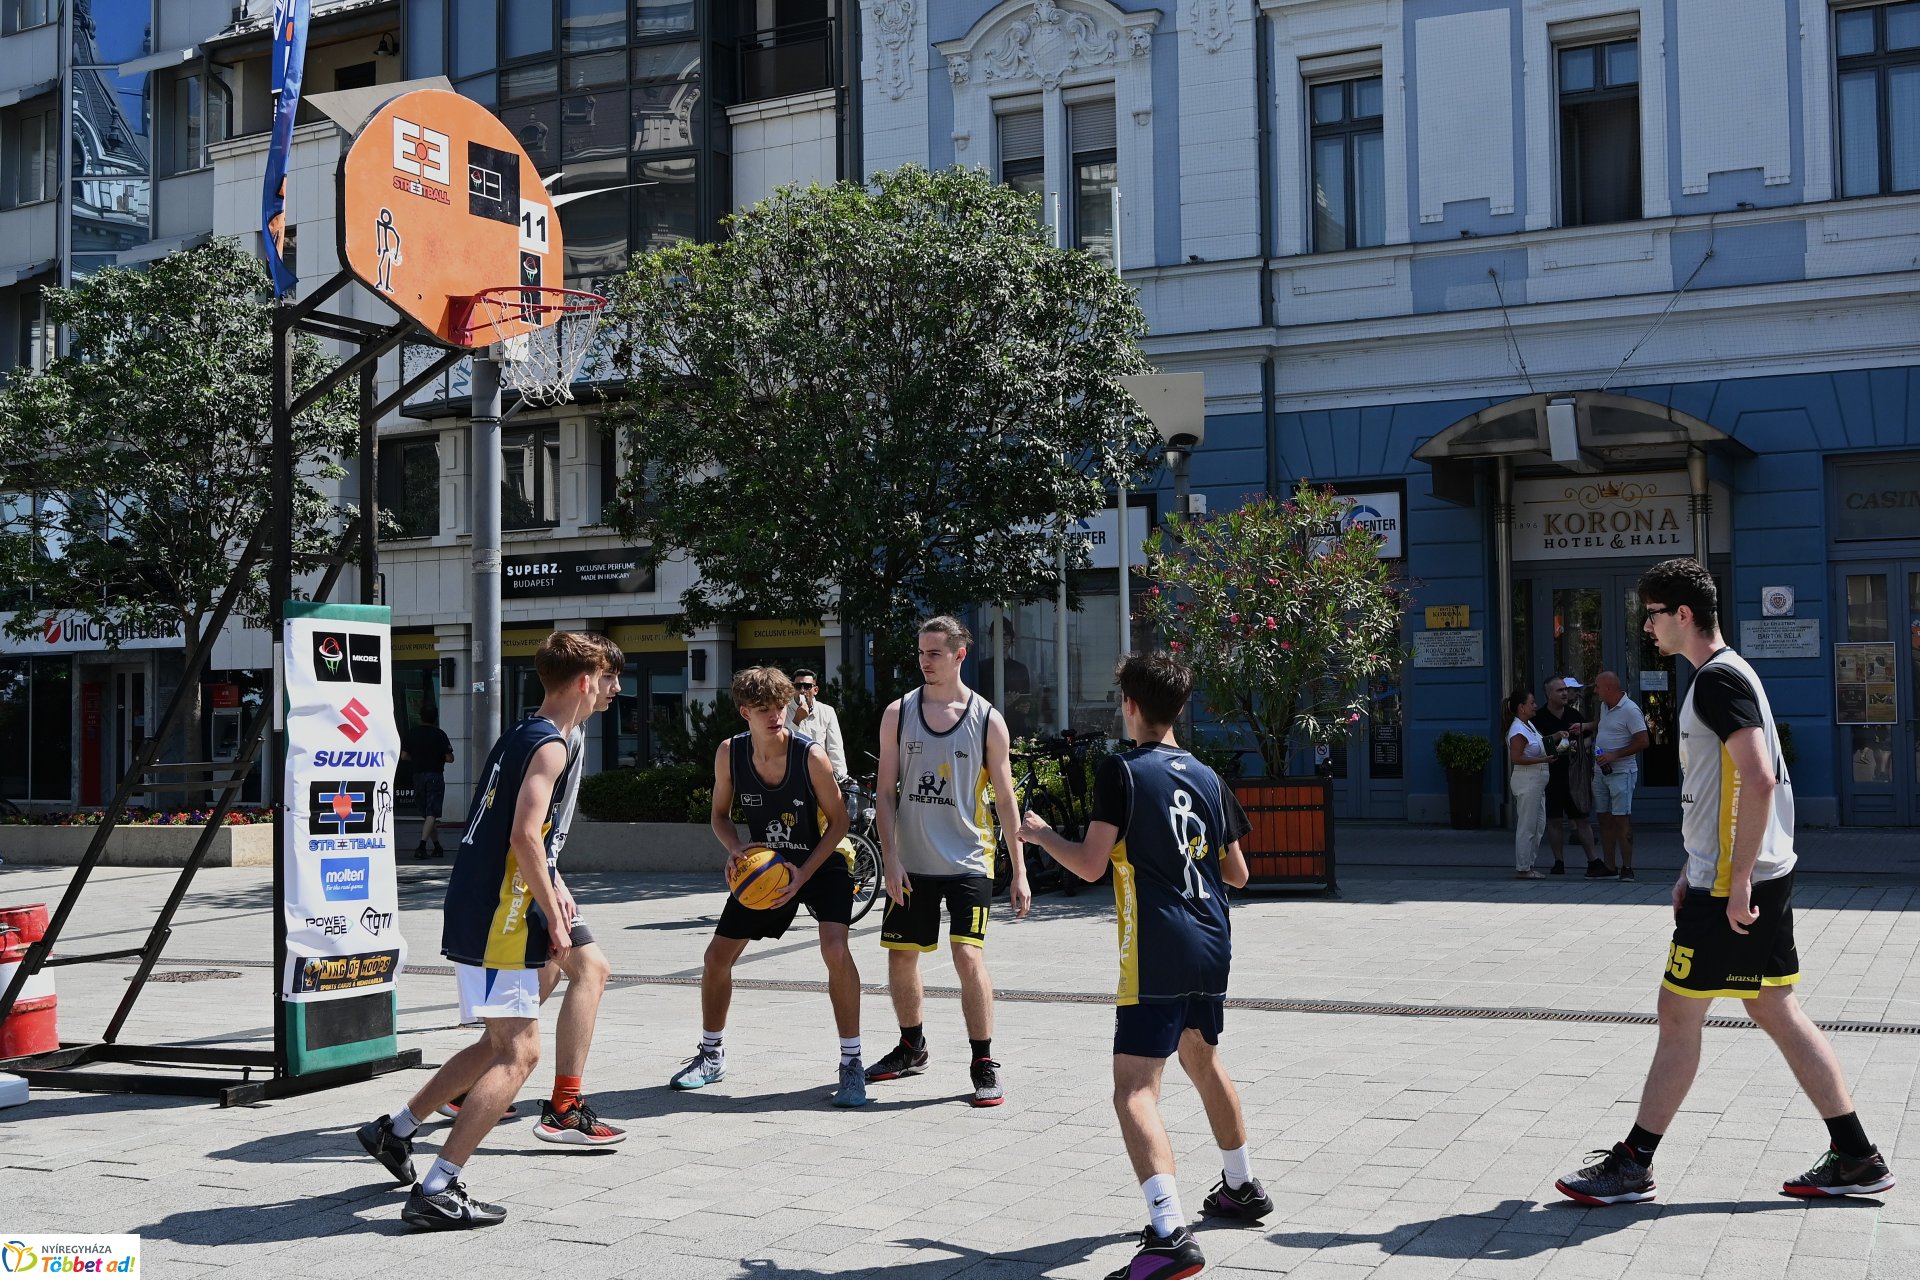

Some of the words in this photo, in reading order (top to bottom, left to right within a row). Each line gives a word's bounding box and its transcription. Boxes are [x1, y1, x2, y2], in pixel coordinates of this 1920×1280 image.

[521, 211, 546, 243] 11
[1543, 508, 1680, 536] KORONA
[1544, 536, 1604, 549] HOTEL
[1610, 533, 1625, 549] &
[1631, 533, 1680, 546] HALL
[506, 563, 563, 577] SUPERZ.
[575, 563, 607, 573] EXCLUSIVE
[607, 562, 636, 571] PERFUME
[513, 578, 555, 589] BUDAPEST
[604, 571, 631, 580] HUNGARY
[313, 750, 385, 768] SUZUKI
[766, 841, 810, 851] REETBALL
[326, 868, 365, 883] molten
[322, 960, 346, 978] KING
[349, 962, 359, 975] OF
[361, 959, 390, 973] HOOPS
[1726, 974, 1764, 983] darazsak.
